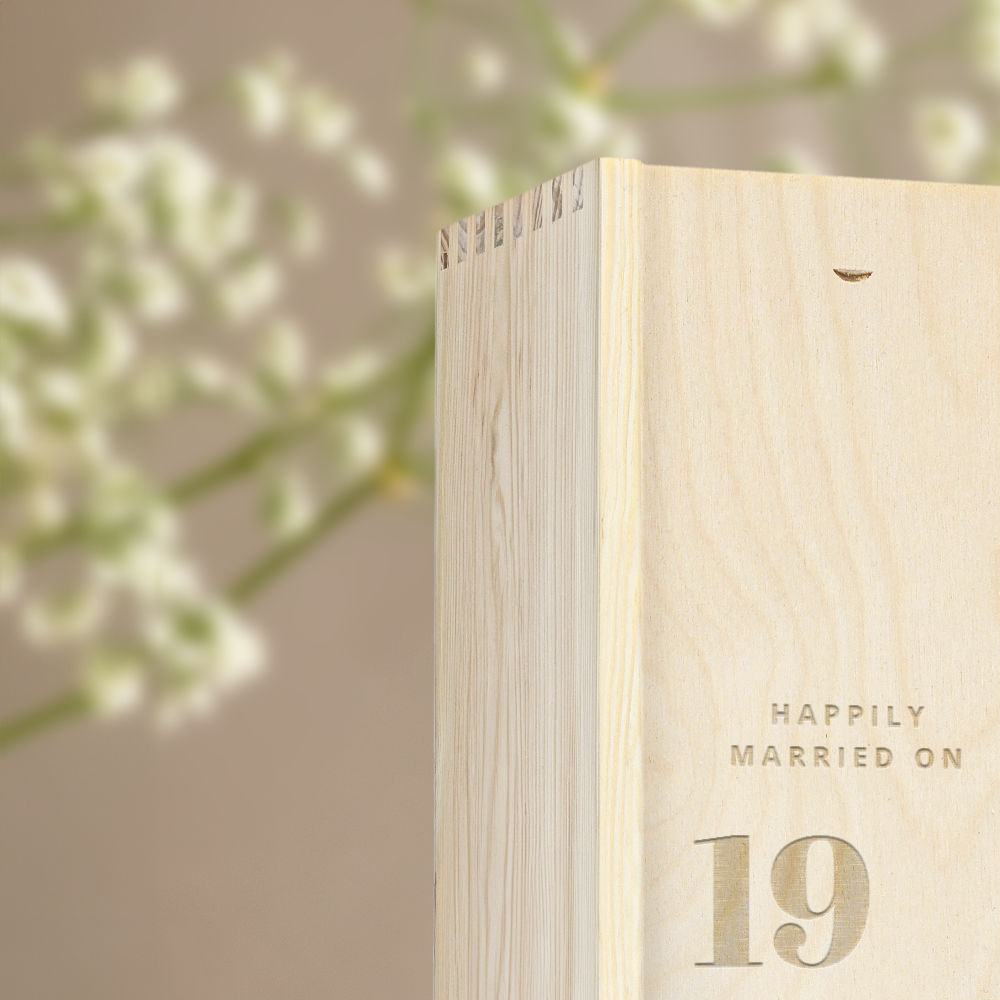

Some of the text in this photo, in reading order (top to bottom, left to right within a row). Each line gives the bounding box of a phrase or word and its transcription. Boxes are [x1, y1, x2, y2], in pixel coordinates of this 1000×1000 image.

[771, 702, 926, 728] HAPPILY
[730, 744, 963, 770] MARRIED ON
[693, 834, 870, 969] 19
